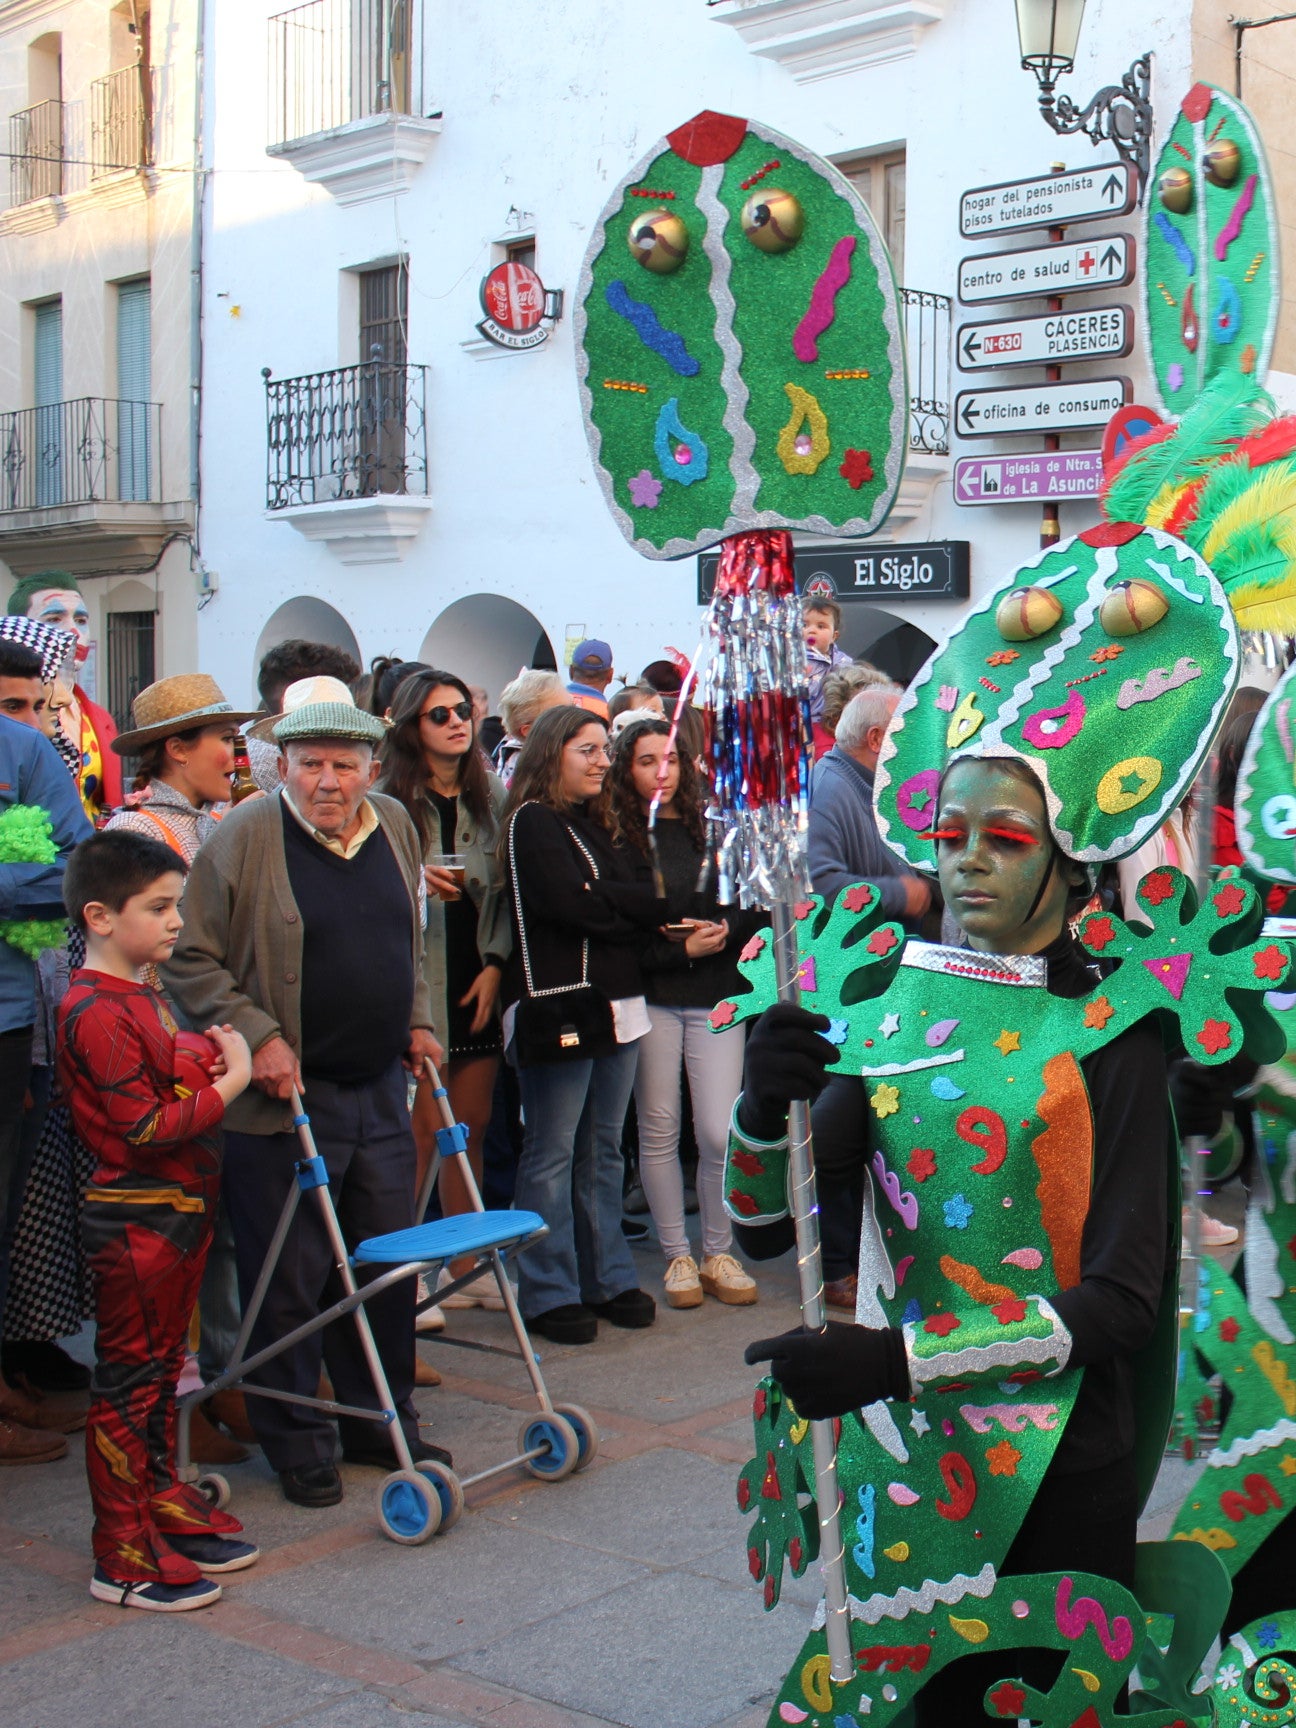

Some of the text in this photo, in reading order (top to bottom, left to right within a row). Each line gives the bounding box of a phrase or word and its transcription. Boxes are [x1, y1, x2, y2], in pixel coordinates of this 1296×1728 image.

[965, 177, 1093, 211] hogar del pensionista
[964, 203, 1053, 230] pisos tutelados
[963, 260, 1070, 288] centro de salud
[489, 323, 545, 345] BAR EL SIGLO
[1044, 314, 1120, 338] CÁCERES
[984, 335, 1021, 353] N-630
[1049, 333, 1120, 354] PLASENCIA
[984, 397, 1119, 419] oficina de consumo
[1006, 461, 1040, 477] iglesia
[1046, 460, 1060, 473] de
[1003, 473, 1105, 495] de La Asunci
[854, 558, 876, 586] El
[880, 556, 933, 590] Siglo
